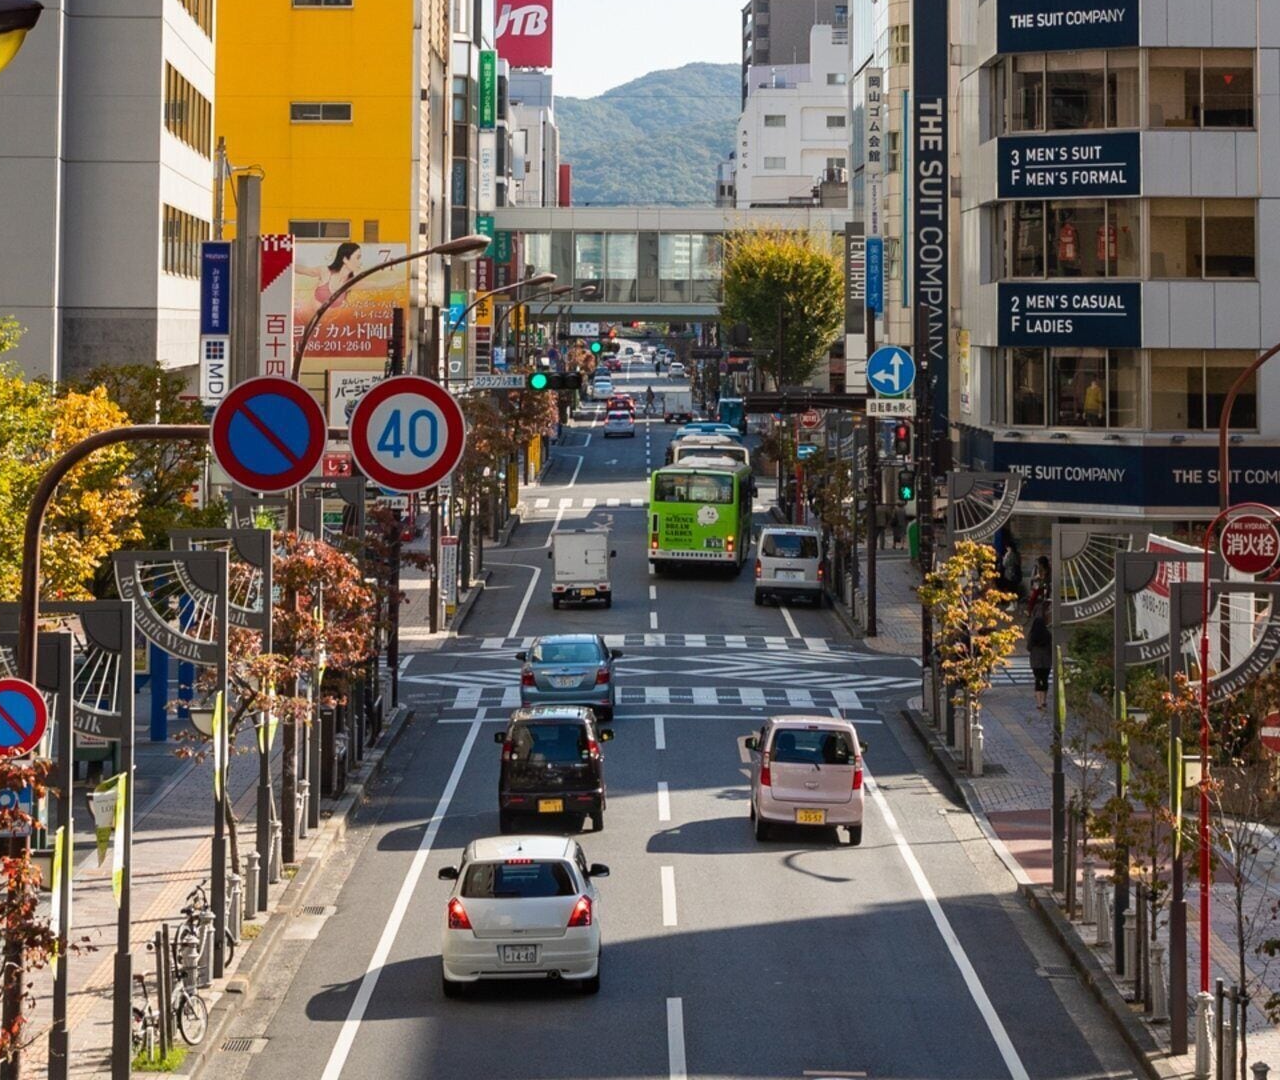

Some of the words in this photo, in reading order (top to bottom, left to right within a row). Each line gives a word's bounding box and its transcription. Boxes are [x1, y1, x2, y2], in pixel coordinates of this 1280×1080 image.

[496, 3, 549, 39] JTB
[1010, 14, 1034, 29] THE
[1036, 11, 1064, 27] SUIT
[1065, 7, 1125, 25] COMPANY
[868, 75, 881, 163] 岡山ゴム会館
[920, 97, 943, 151] THE
[1025, 145, 1068, 162] MEN'S
[1071, 145, 1102, 160] SUIT
[1025, 170, 1068, 186] MEN'S
[1071, 169, 1127, 185] FORMAL
[919, 159, 944, 221] SUIT
[1025, 295, 1068, 310] MEN'S
[1071, 294, 1125, 310] CASUAL
[1025, 319, 1073, 334] LADIES
[302, 340, 372, 352] 86-201-2640
[870, 402, 912, 413] 自転車を除く
[377, 409, 439, 458] 40
[1009, 464, 1032, 479] THE
[1035, 466, 1062, 481] SUIT
[1064, 467, 1125, 482] COMPANY
[1172, 469, 1202, 484] THE
[1206, 469, 1240, 484] SIT
[1244, 522, 1270, 530] HYDRANT
[1226, 533, 1276, 556] 消火栓
[167, 631, 202, 659] Walk
